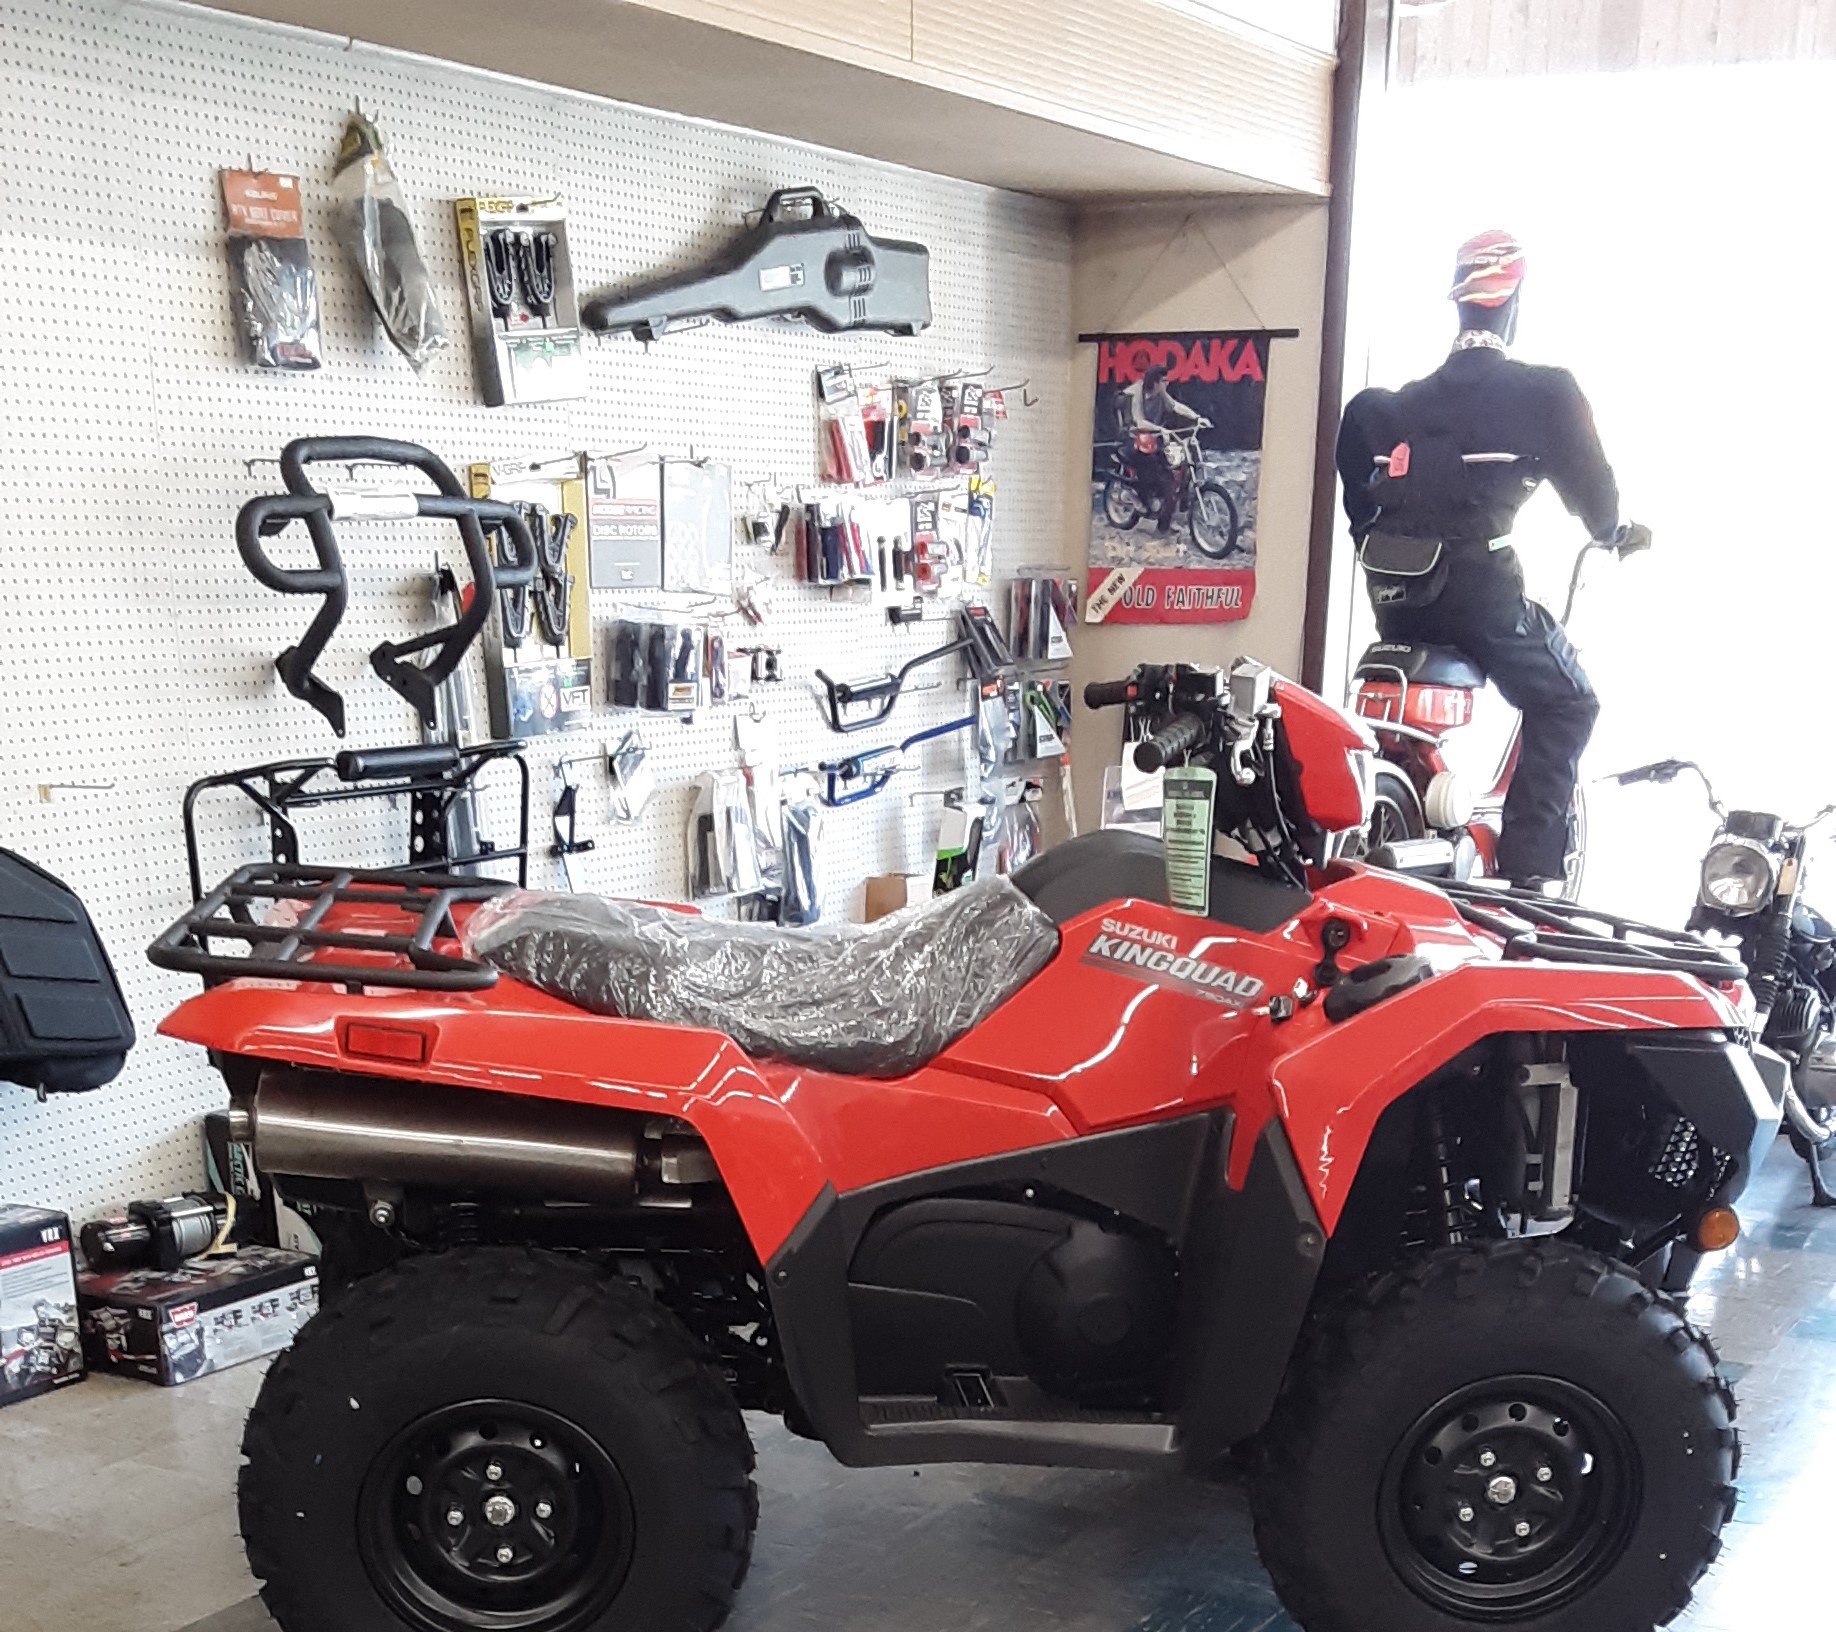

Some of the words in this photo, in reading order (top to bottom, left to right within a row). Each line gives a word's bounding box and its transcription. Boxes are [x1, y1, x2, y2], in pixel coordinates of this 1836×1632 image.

[1099, 338, 1263, 384] HODAKA
[1107, 573, 1126, 596] NEW
[1122, 584, 1156, 609] OLD
[1165, 585, 1243, 610] FAITHFUL
[562, 688, 589, 706] VFT
[1101, 917, 1179, 950] SUZUKI
[1088, 933, 1265, 998] KINGQUAD
